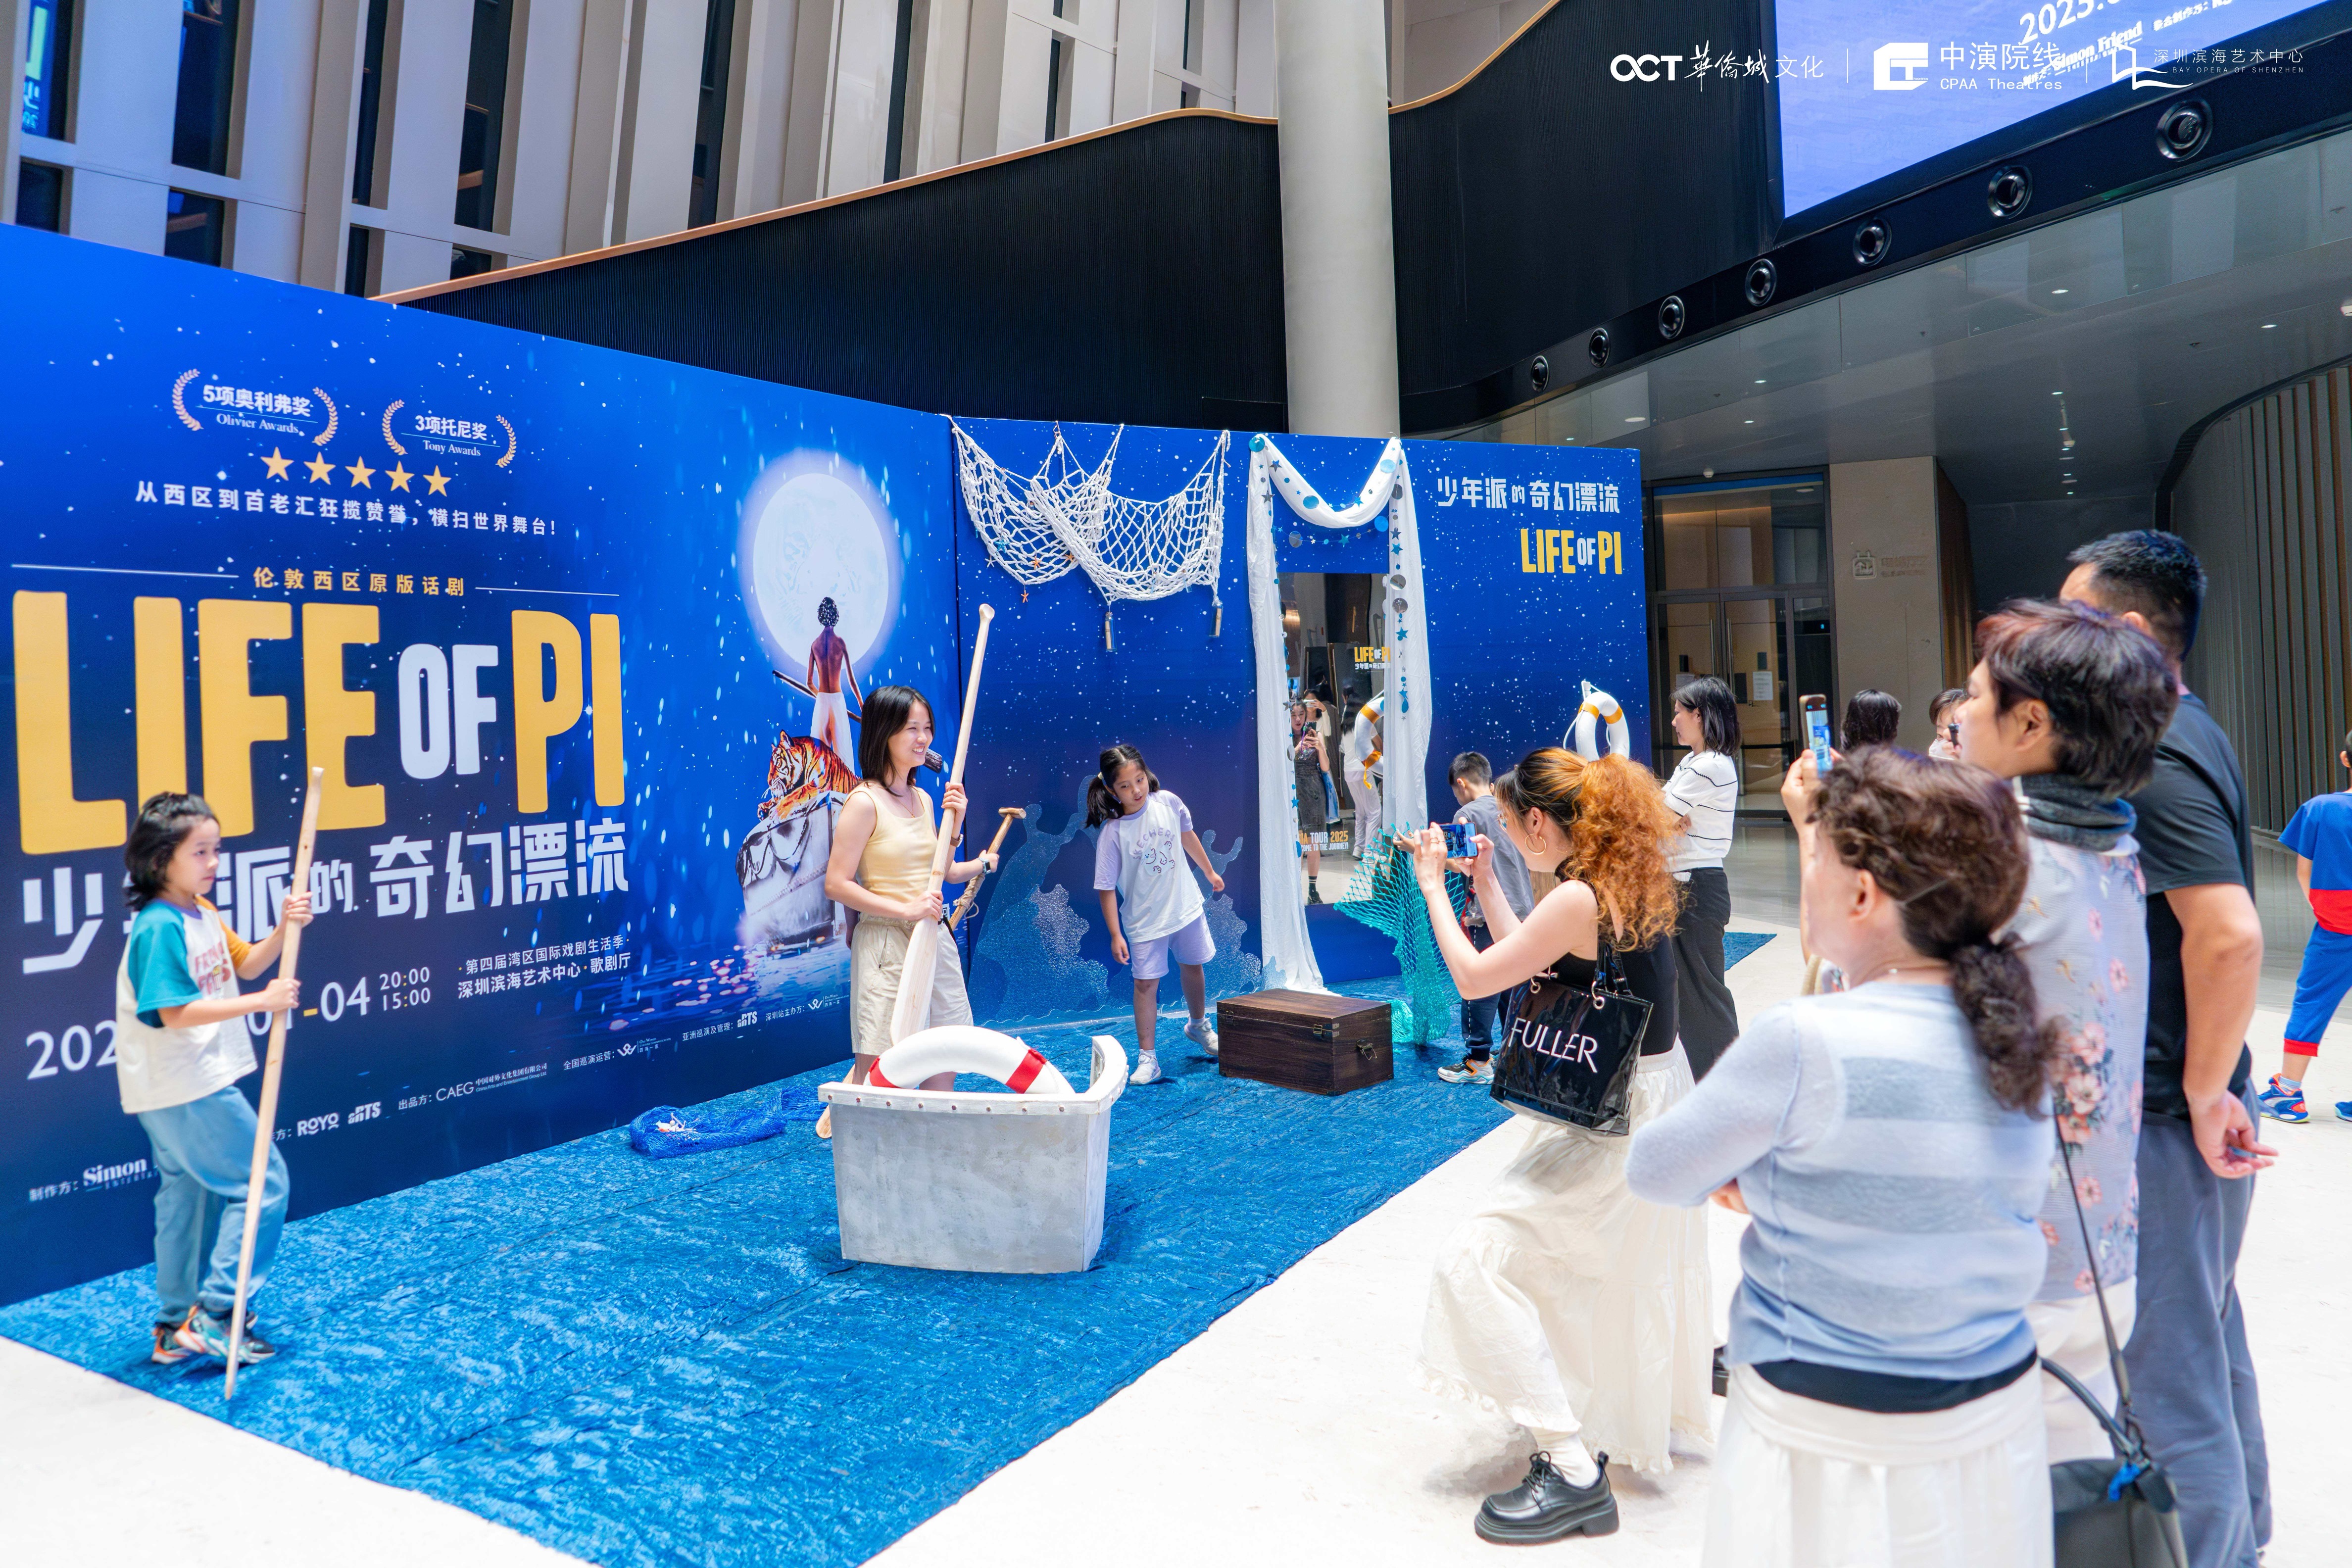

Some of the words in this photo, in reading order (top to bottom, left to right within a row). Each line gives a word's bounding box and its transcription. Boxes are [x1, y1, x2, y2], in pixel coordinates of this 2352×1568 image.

[203, 385, 311, 417] 5项奥利弗奖
[216, 413, 257, 429] Olivier
[259, 419, 299, 434] Awards
[415, 415, 487, 441] 3项托尼奖
[423, 440, 446, 454] Tony
[448, 443, 481, 456] Awards
[1437, 476, 1620, 513] 少年派的奇幻漂流
[1520, 529, 1576, 574] LIFE
[1576, 538, 1596, 566] OF
[1598, 531, 1622, 574] PI
[253, 566, 464, 596] 伦敦西区原版话剧
[1354, 646, 1374, 662] LIFE
[1374, 649, 1381, 659] OF
[12, 589, 387, 855] LIFE
[398, 643, 498, 779] OF
[511, 609, 625, 814] PI
[1133, 827, 1175, 860] SKECHERS
[1310, 832, 1328, 843] TOUR
[1330, 831, 1348, 842] 2025
[23, 817, 629, 974] 少派的奇幻漂流
[379, 967, 430, 990] 20:00
[383, 987, 431, 1011] 15:00
[1508, 1017, 1598, 1073] FULLER
[436, 1081, 474, 1101] CAEG
[297, 1113, 340, 1137] ROYO
[83, 1158, 147, 1186] Simon
